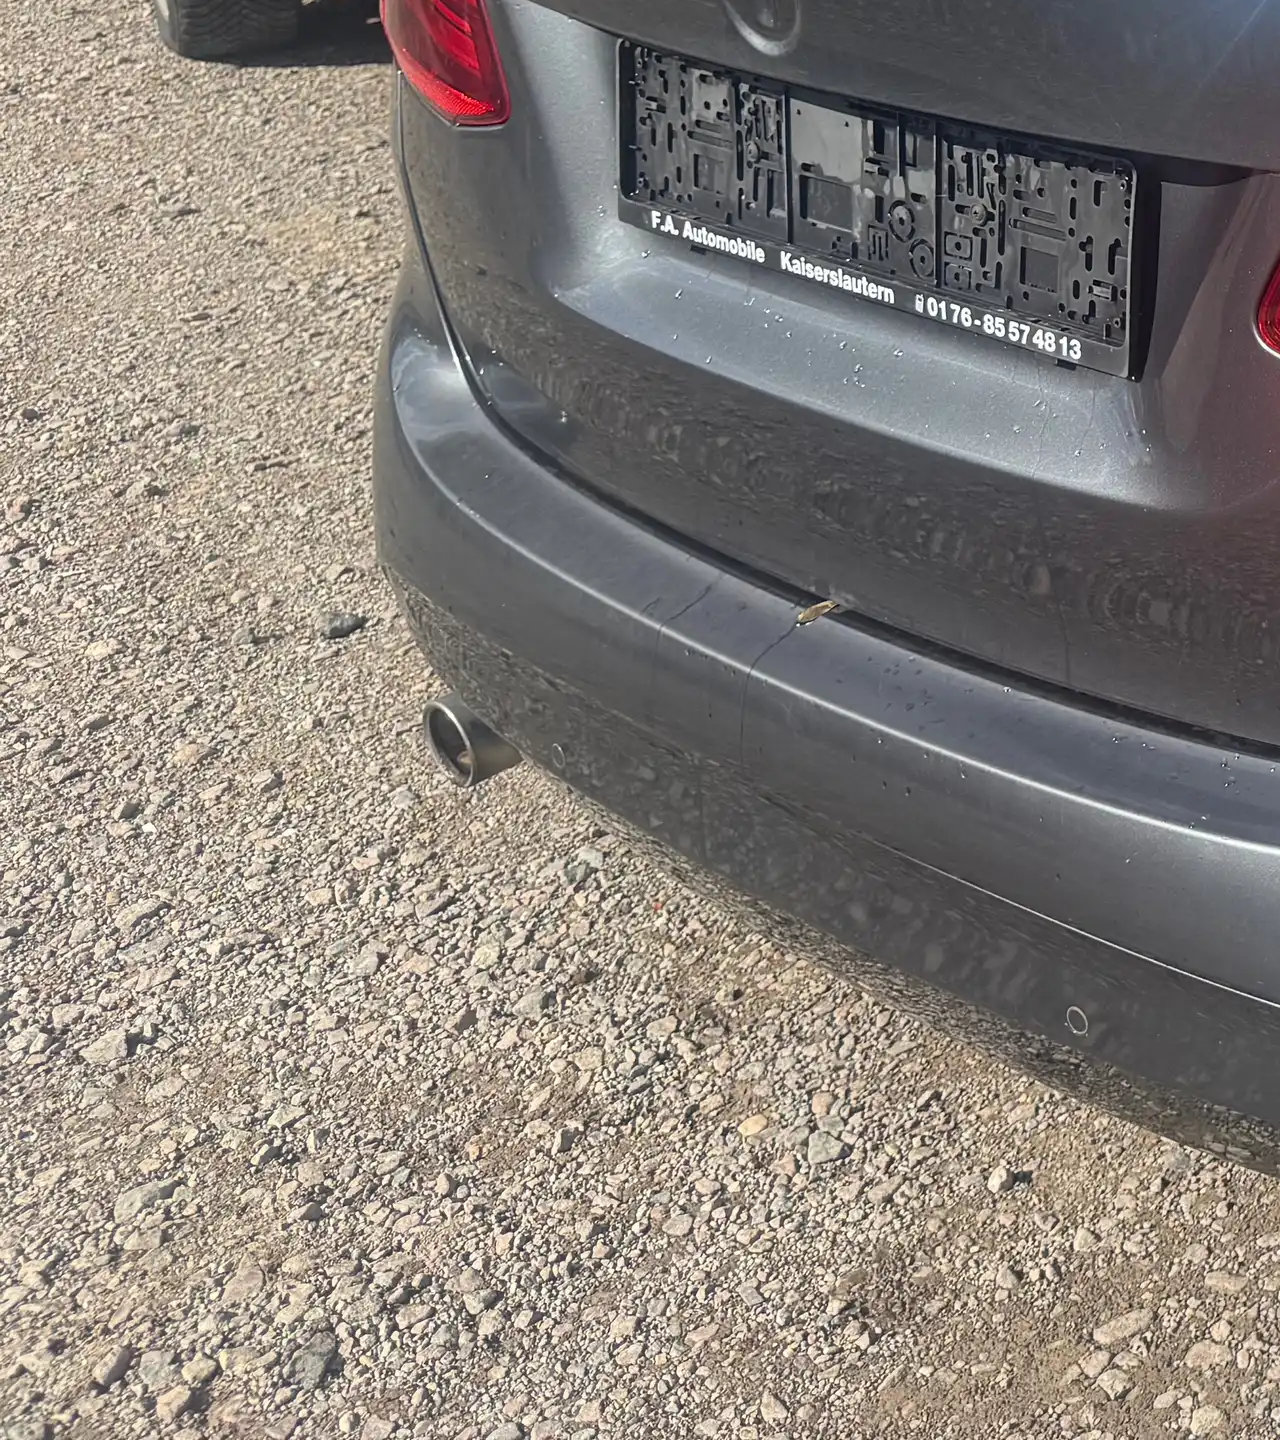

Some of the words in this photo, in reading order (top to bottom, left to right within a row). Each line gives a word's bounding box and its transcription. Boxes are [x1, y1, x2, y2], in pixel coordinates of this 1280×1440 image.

[650, 210, 680, 237] F.A.
[682, 219, 767, 263] Automobile
[780, 250, 895, 305] Kaiserslautern
